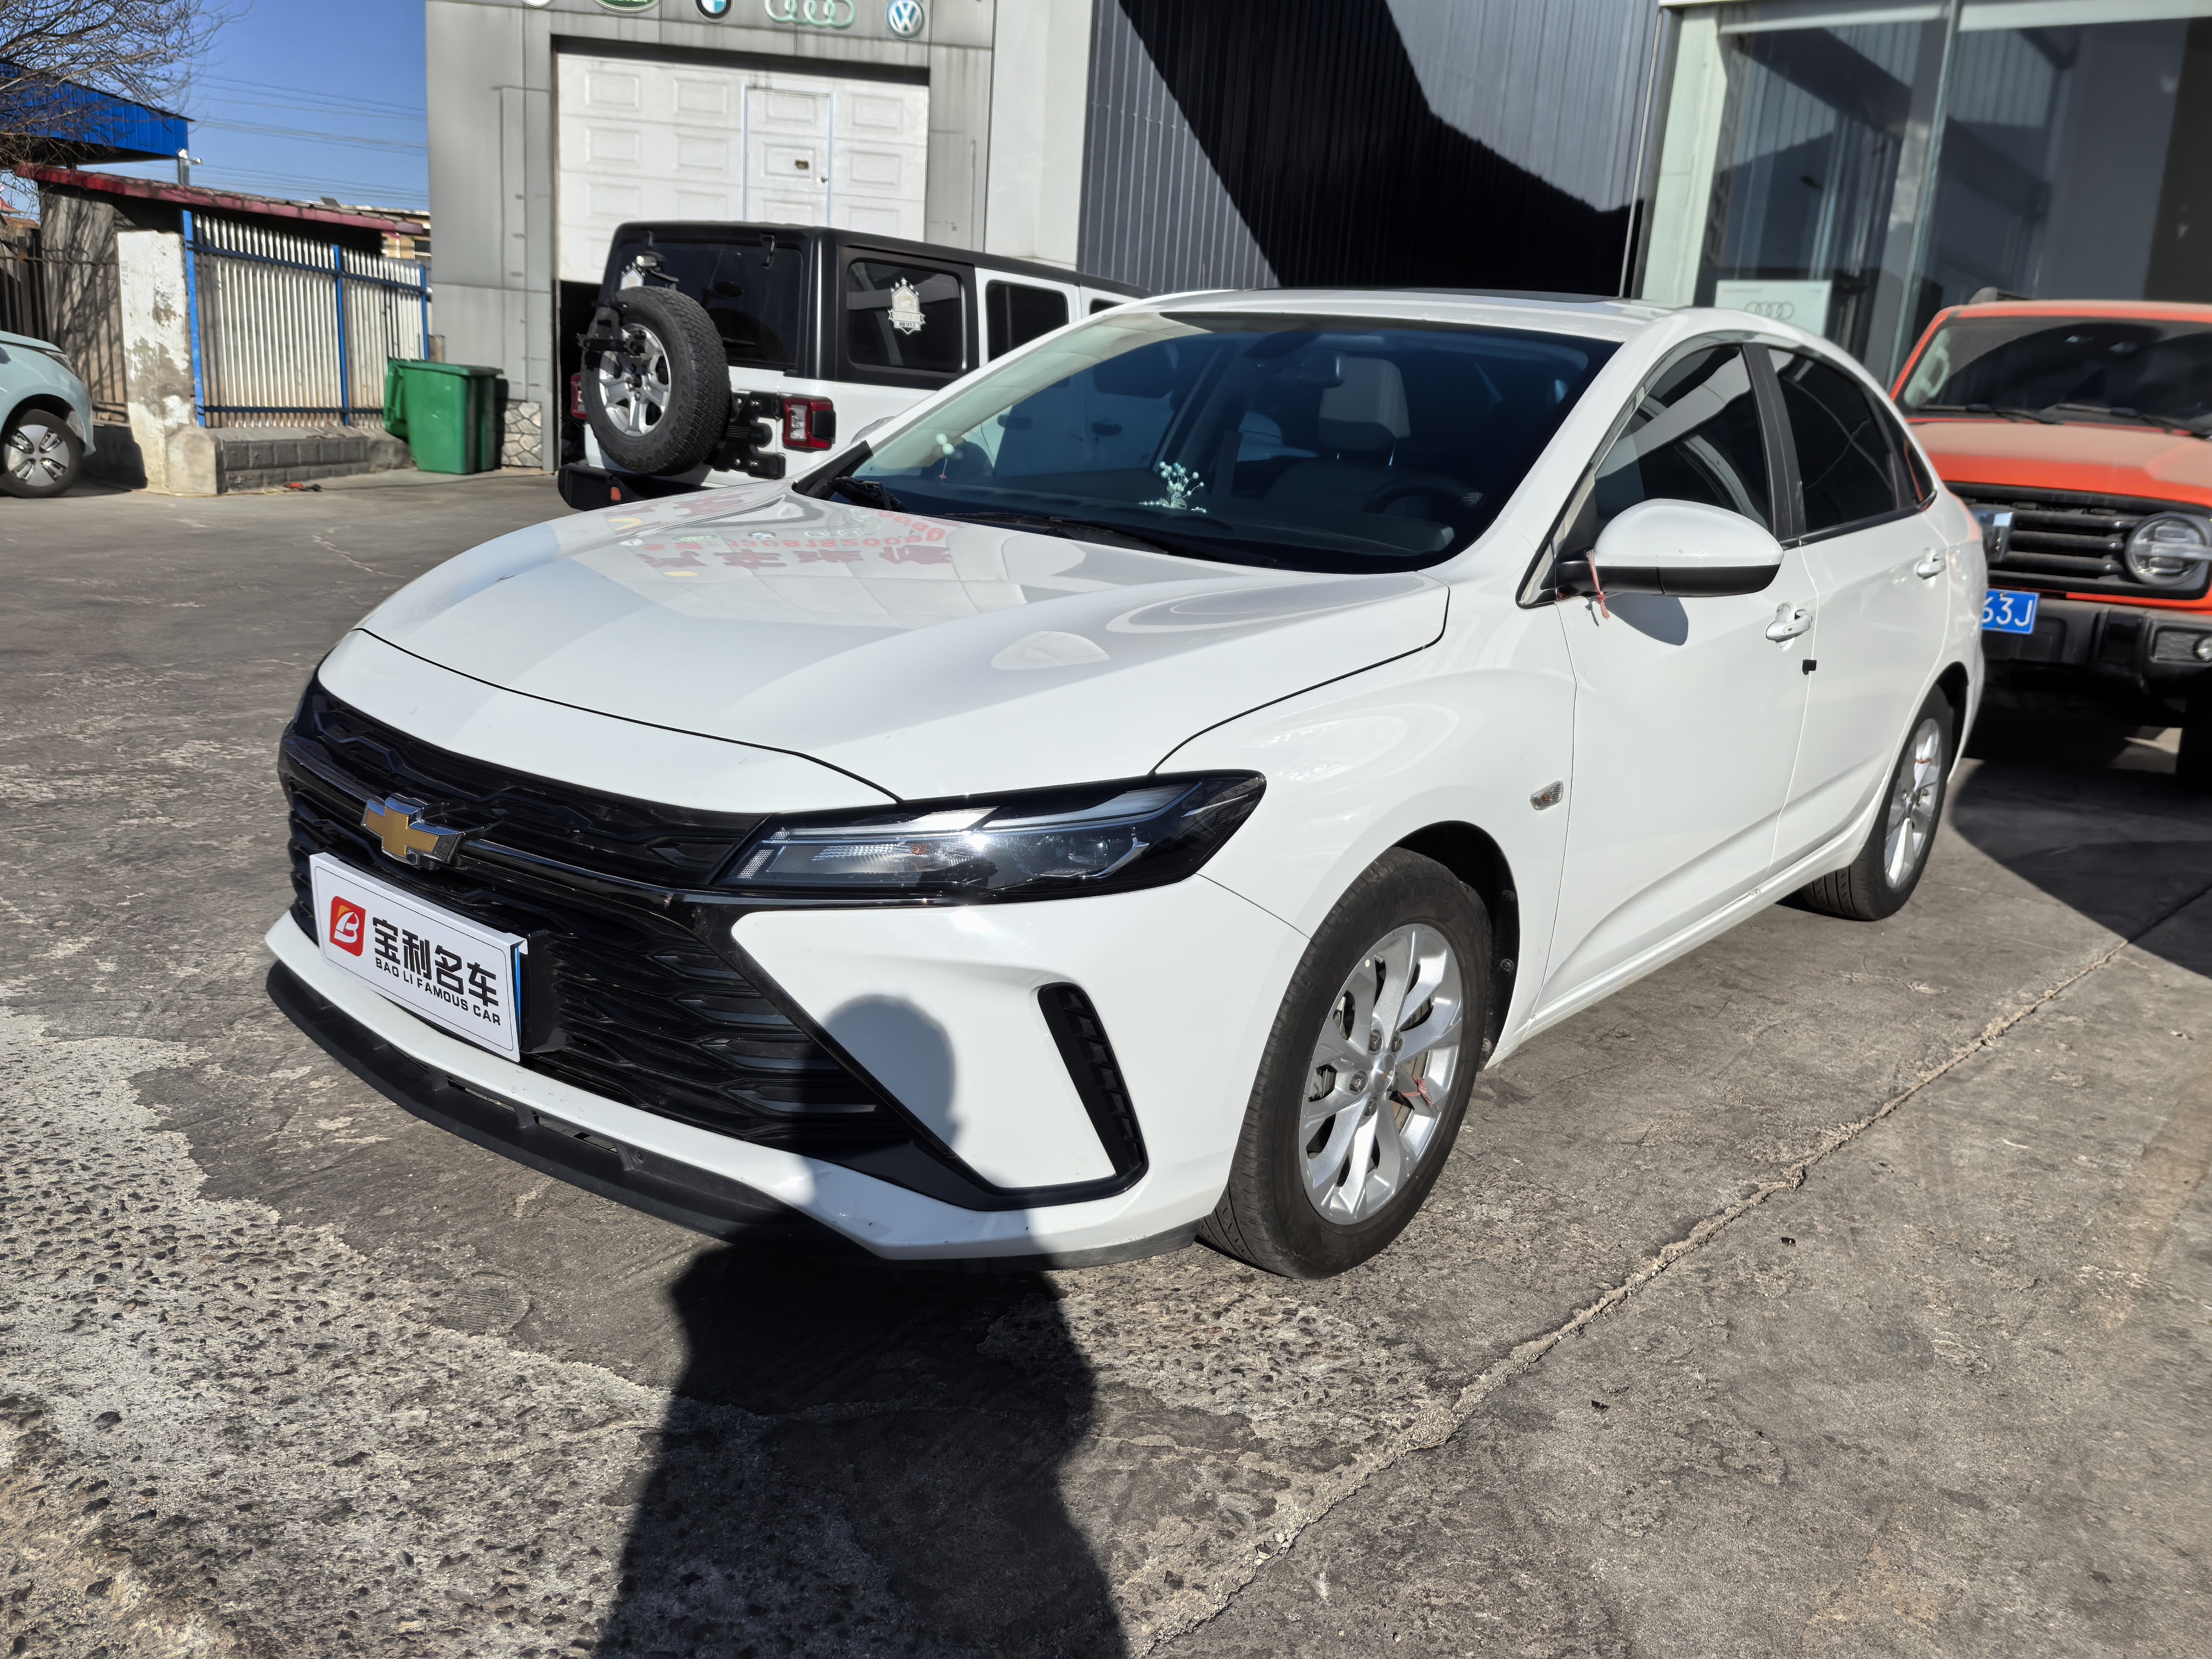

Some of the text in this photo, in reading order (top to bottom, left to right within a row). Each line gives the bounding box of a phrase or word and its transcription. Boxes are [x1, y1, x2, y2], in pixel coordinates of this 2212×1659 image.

[373, 916, 499, 1007] 宝利名车
[375, 956, 501, 1026] BAO LI FAMOUS CAR
